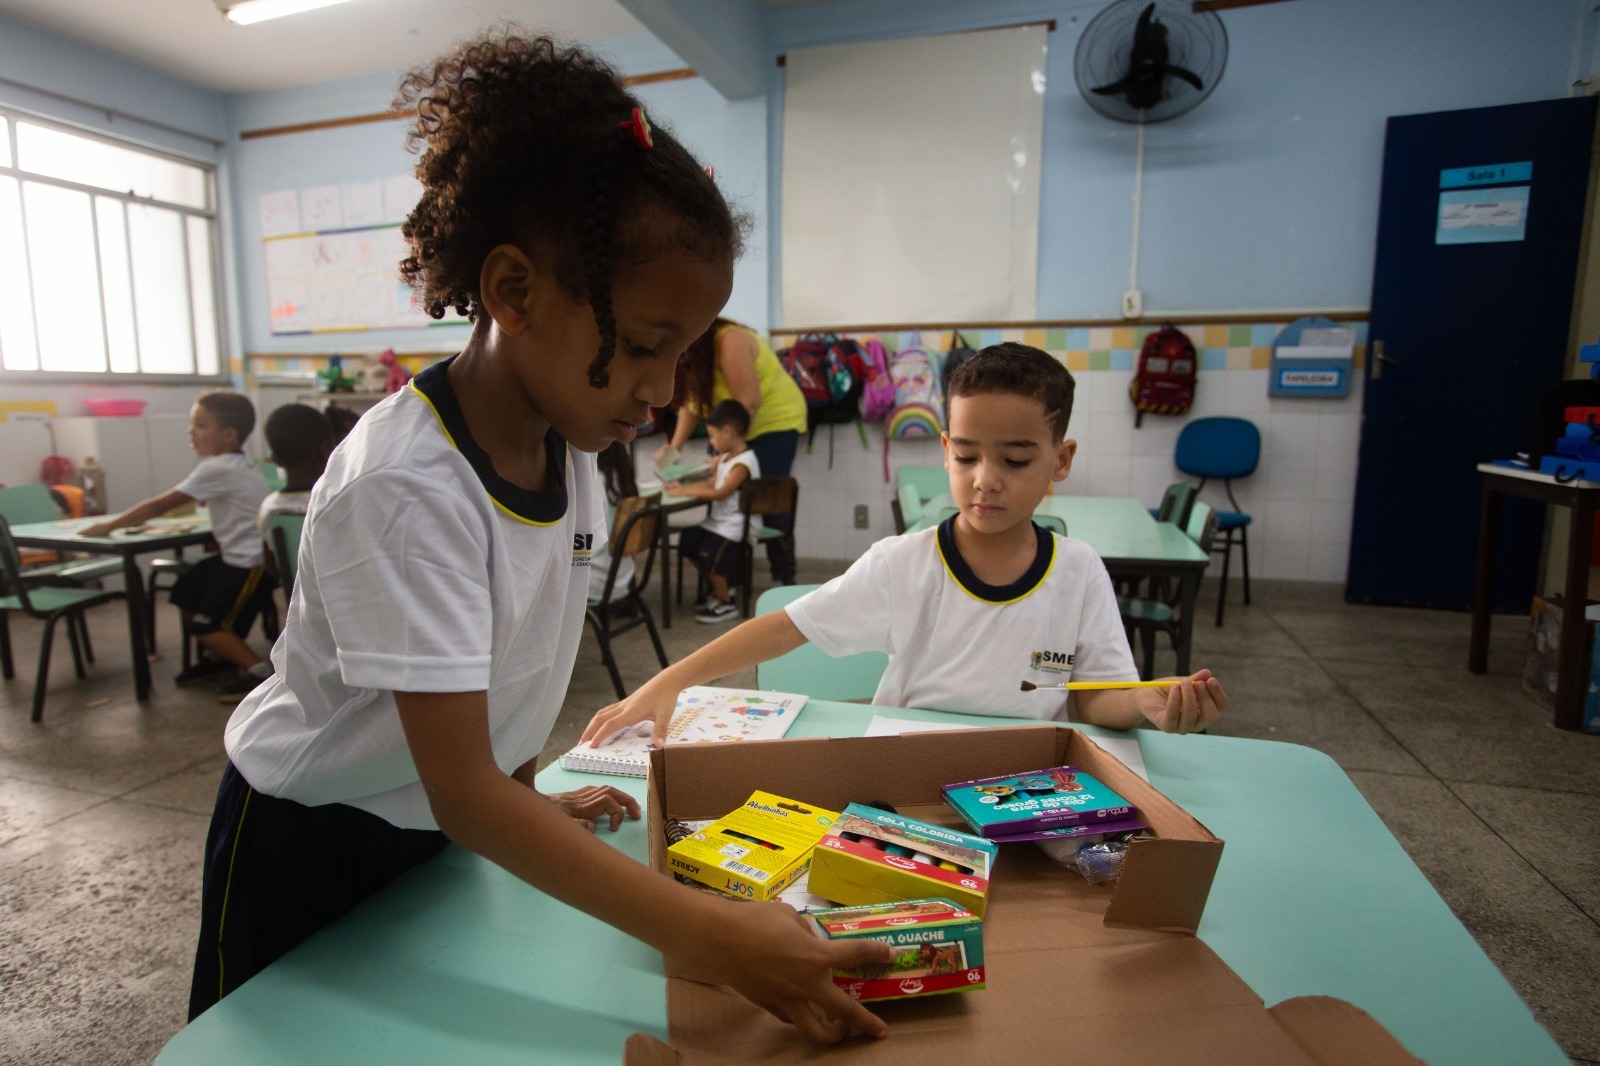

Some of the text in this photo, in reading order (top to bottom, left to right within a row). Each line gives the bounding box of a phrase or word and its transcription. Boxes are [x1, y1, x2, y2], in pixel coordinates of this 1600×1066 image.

[1467, 168, 1505, 181] Sala 1
[1043, 650, 1075, 665] SME
[747, 800, 789, 817] Abelhinhas
[877, 815, 906, 828] COLA
[908, 824, 964, 844] COLORIDA
[671, 858, 700, 875] ACRILEX
[724, 878, 755, 897] SOFT
[767, 879, 786, 896] ACRILEX
[897, 931, 945, 943] GUACHE
[967, 972, 981, 981] 06
